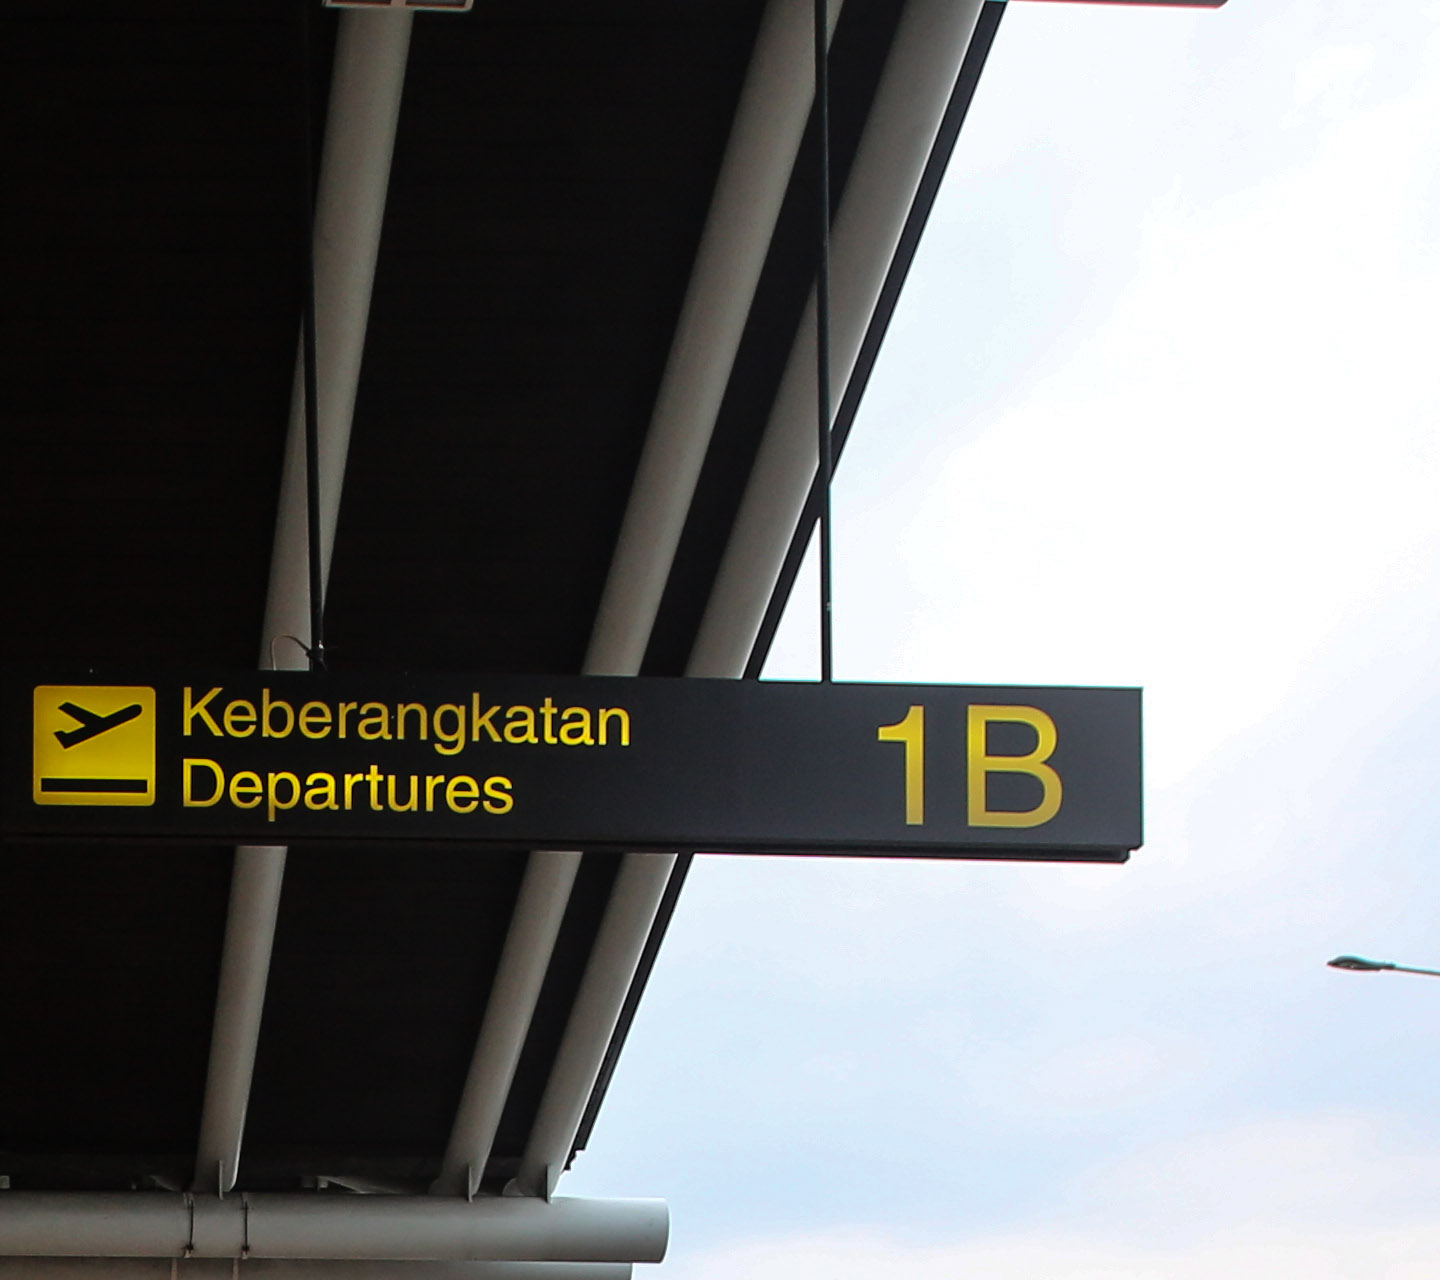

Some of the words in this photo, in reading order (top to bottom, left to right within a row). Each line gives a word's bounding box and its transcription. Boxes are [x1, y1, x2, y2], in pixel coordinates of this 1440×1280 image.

[183, 686, 631, 756] Keberangkatan
[182, 758, 515, 822] Departures
[877, 704, 1063, 827] 1B
